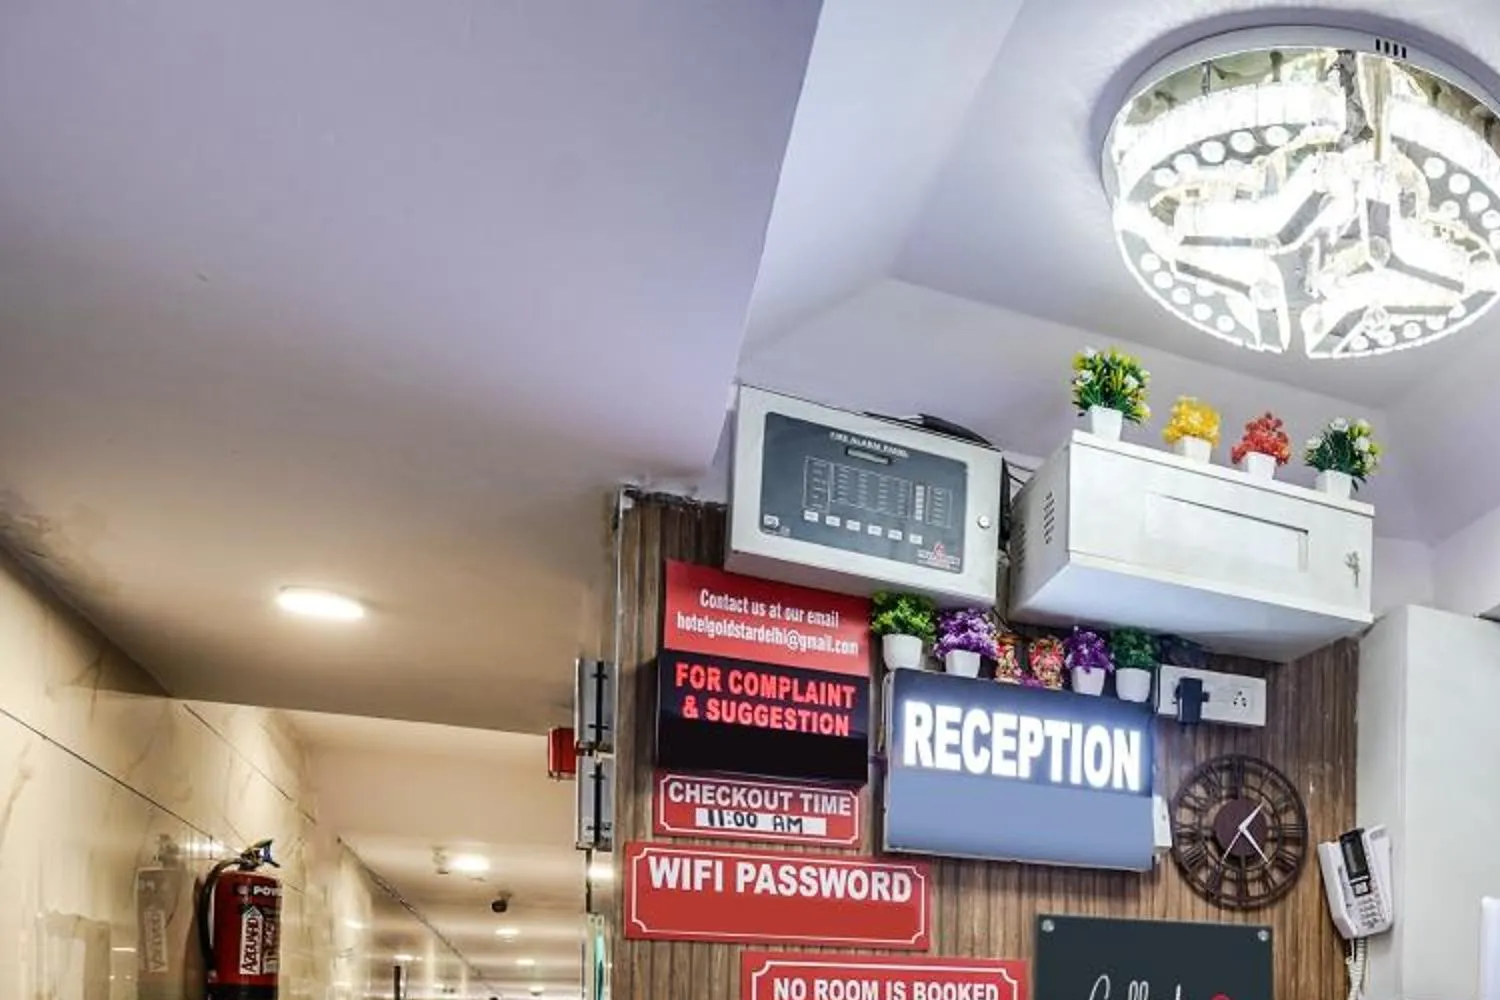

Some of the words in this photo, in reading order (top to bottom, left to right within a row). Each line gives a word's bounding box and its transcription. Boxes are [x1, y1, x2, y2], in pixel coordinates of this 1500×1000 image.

[700, 588, 749, 613] Contact
[751, 602, 766, 618] us
[769, 604, 781, 619] at
[786, 608, 803, 623] our
[807, 611, 839, 628] email
[677, 611, 859, 655] hotelgoldstardelhi@gmail.com
[675, 662, 722, 692] FOR
[728, 669, 857, 709] COMPLAINT
[682, 695, 699, 719] &
[706, 698, 850, 737] SUGGESTION
[903, 699, 1142, 792] RECEPTION
[668, 781, 793, 812] CHECKOUT
[800, 793, 851, 816] TIME
[706, 811, 758, 829] 11:00
[773, 816, 803, 833] AM
[649, 855, 724, 892] WIFI
[736, 862, 912, 903] PASSWORD
